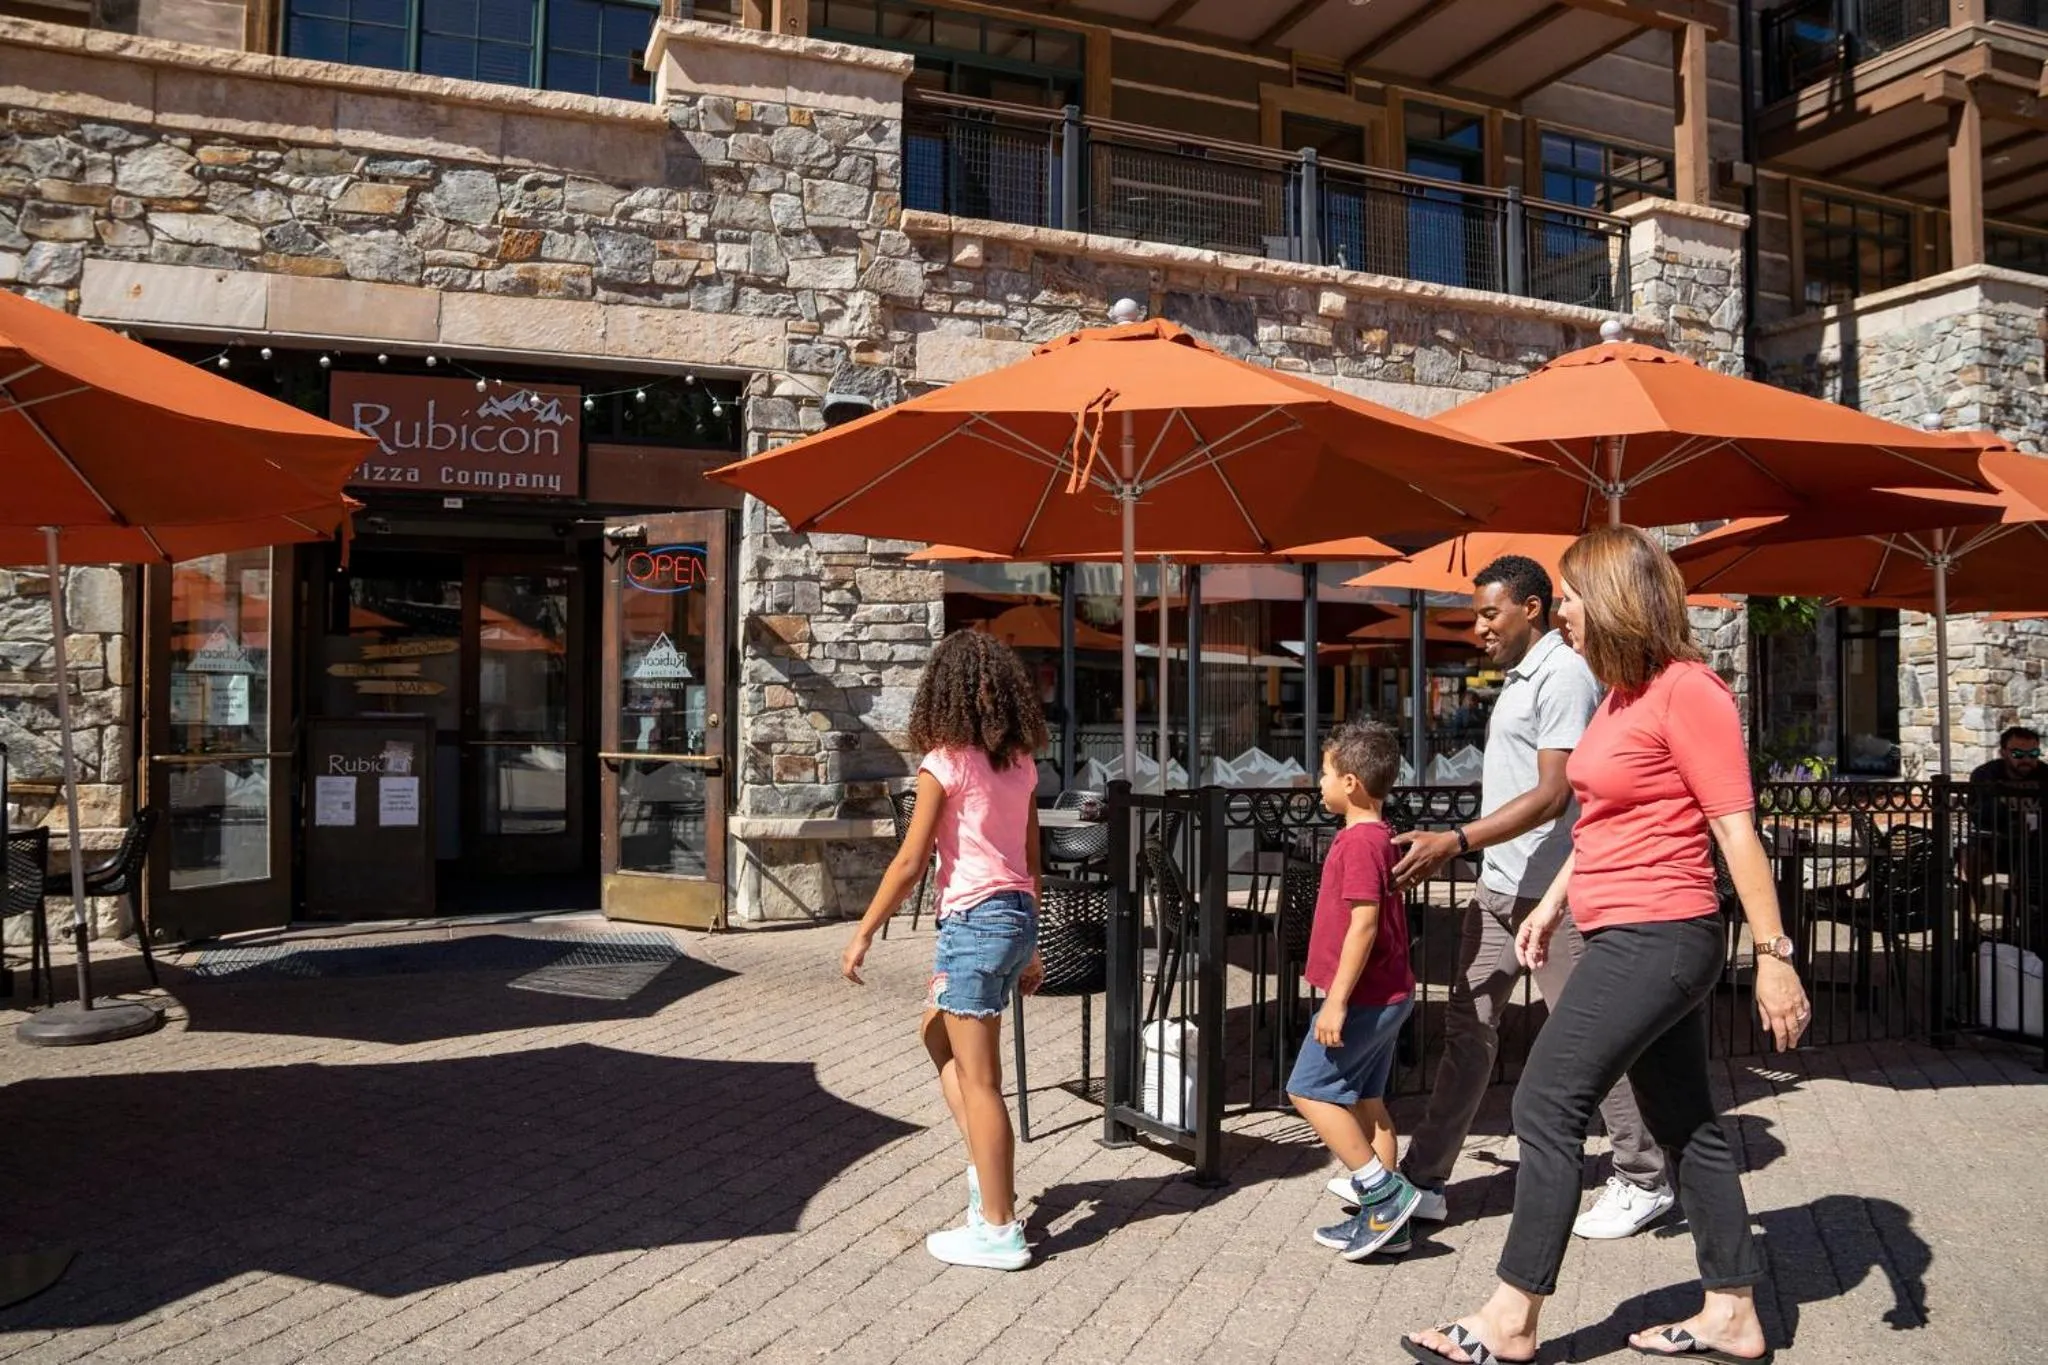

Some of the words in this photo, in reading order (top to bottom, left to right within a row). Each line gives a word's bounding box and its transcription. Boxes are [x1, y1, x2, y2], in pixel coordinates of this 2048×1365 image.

[352, 400, 560, 455] Rubicon
[348, 462, 420, 481] izza
[441, 466, 561, 492] Company
[627, 552, 708, 584] OPEN
